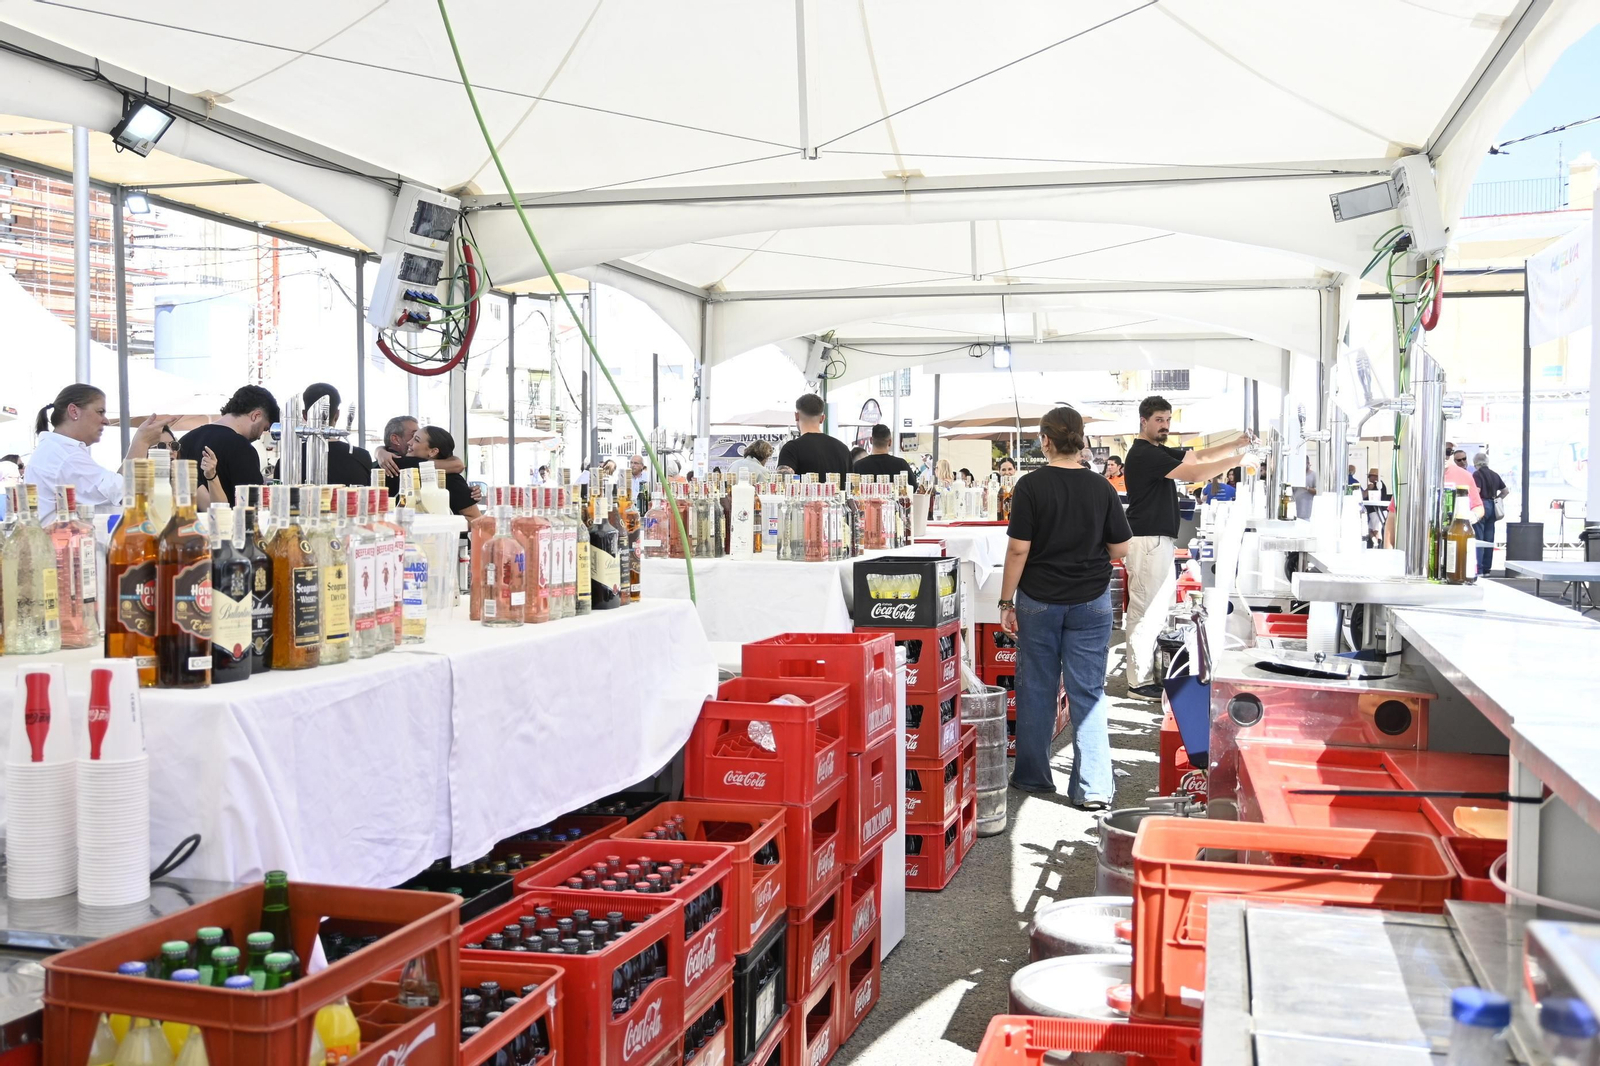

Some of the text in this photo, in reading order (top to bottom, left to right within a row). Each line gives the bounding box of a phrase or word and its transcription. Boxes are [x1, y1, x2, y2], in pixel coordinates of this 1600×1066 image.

[871, 602, 917, 620] Coca-Cola
[723, 770, 767, 787] Coca-Cola
[863, 804, 892, 841] CRUZCAMPO
[685, 927, 716, 987] Coca-Cola
[623, 997, 662, 1062] Coca-Cola
